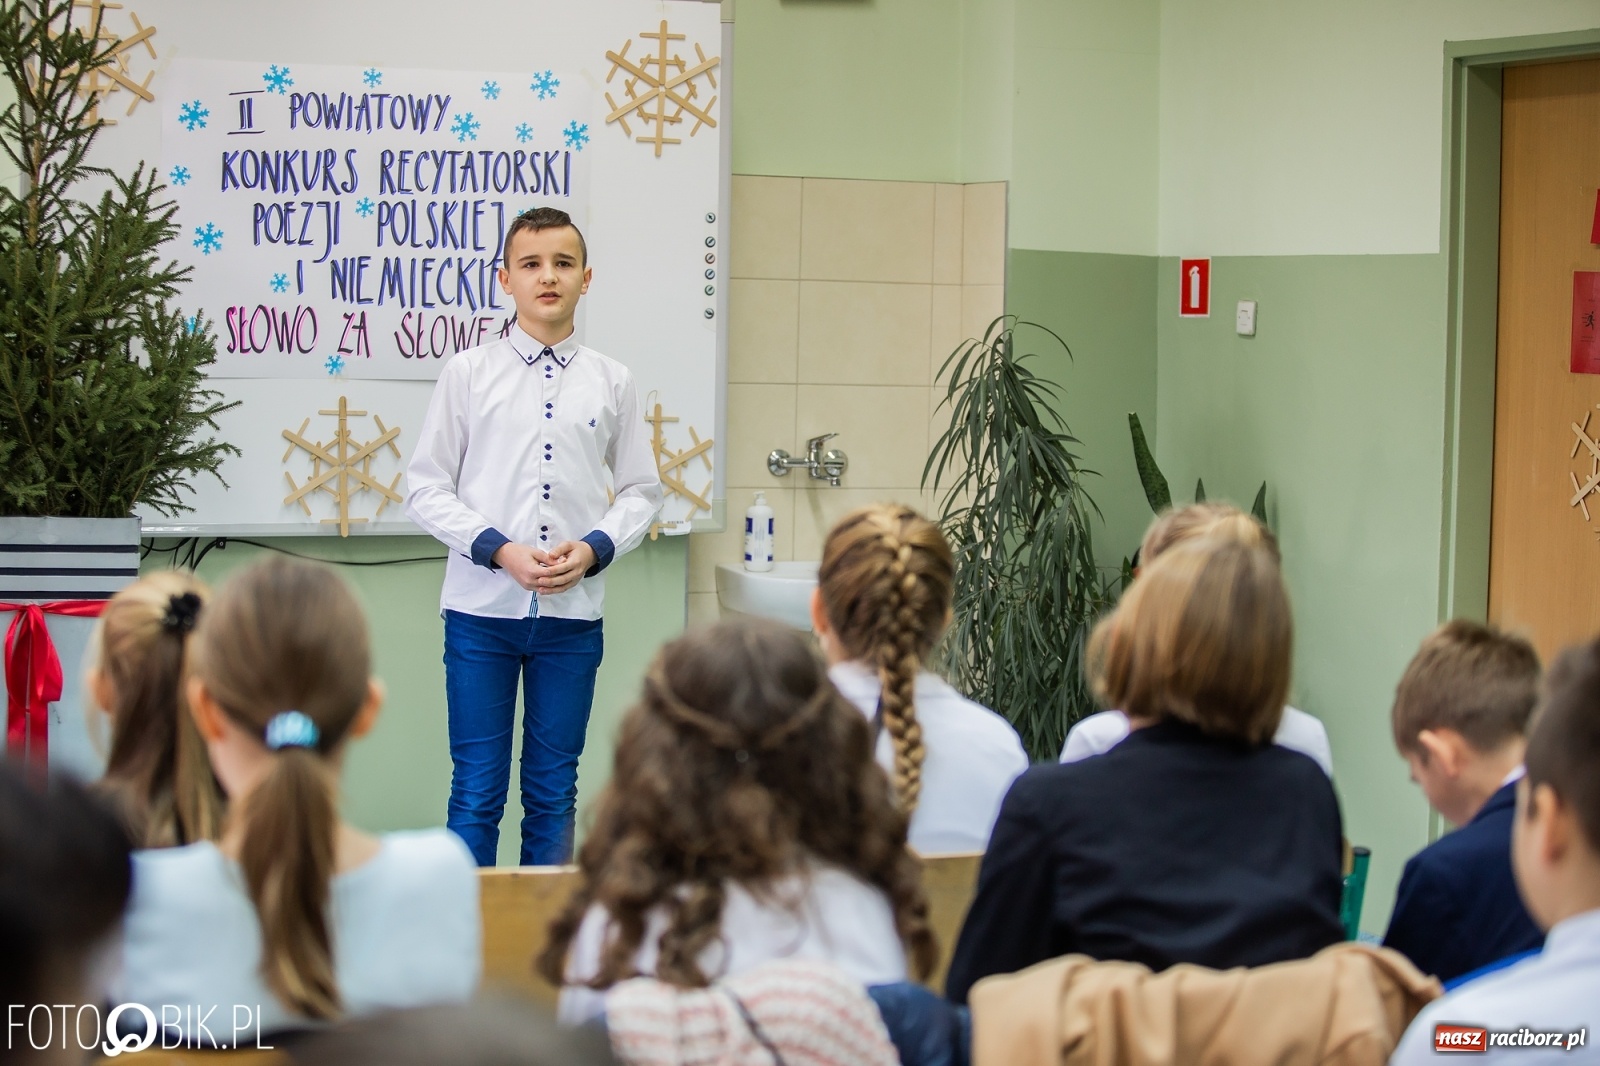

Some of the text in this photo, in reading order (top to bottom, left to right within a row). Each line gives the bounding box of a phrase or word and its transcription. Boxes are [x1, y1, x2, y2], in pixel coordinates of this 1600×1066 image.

[227, 90, 265, 135] II
[221, 148, 571, 197] KONKURS RECYTATORSKI
[253, 199, 505, 268] POEZJI POLSKIEJ
[296, 255, 517, 318] I NIEMIECKIE
[226, 304, 319, 354] SŁOWO
[337, 310, 372, 359] ZA
